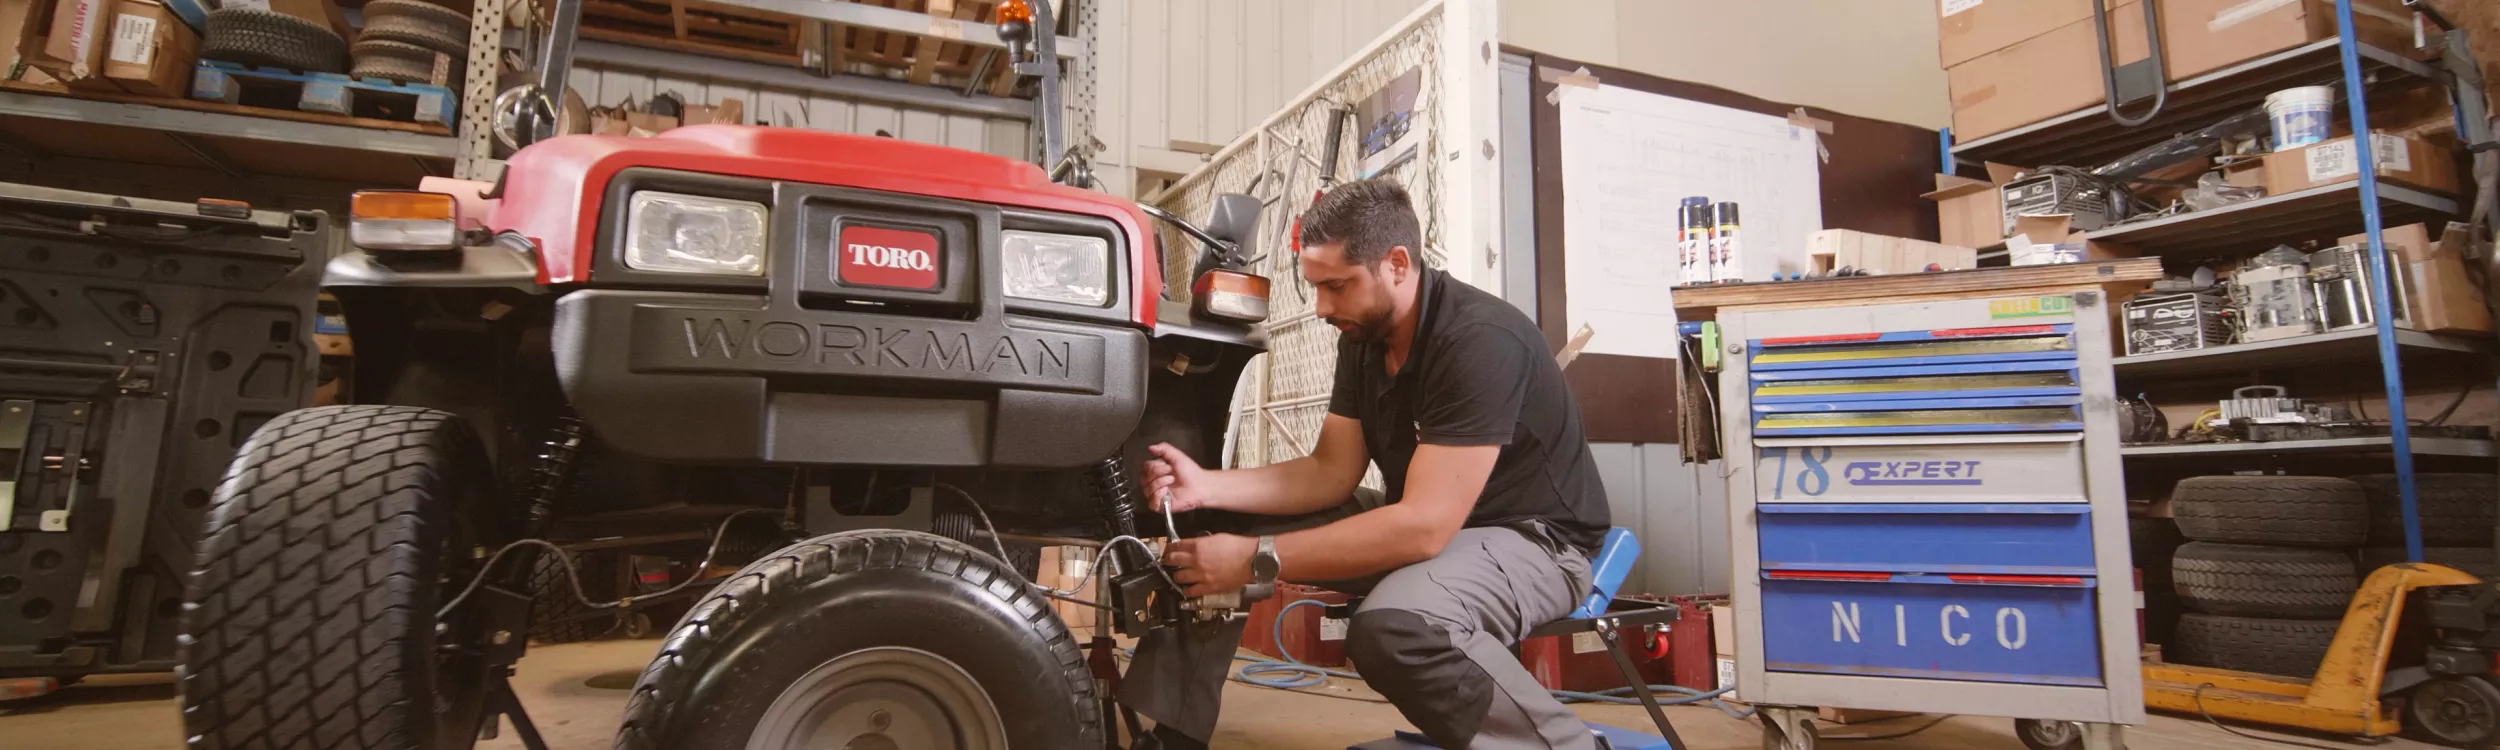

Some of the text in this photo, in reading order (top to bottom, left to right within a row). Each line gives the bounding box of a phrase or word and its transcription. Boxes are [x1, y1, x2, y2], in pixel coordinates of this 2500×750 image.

[684, 318, 1071, 379] WORKMAN
[1759, 446, 1981, 500] 78 EXPERT
[1832, 601, 2027, 650] NICO
